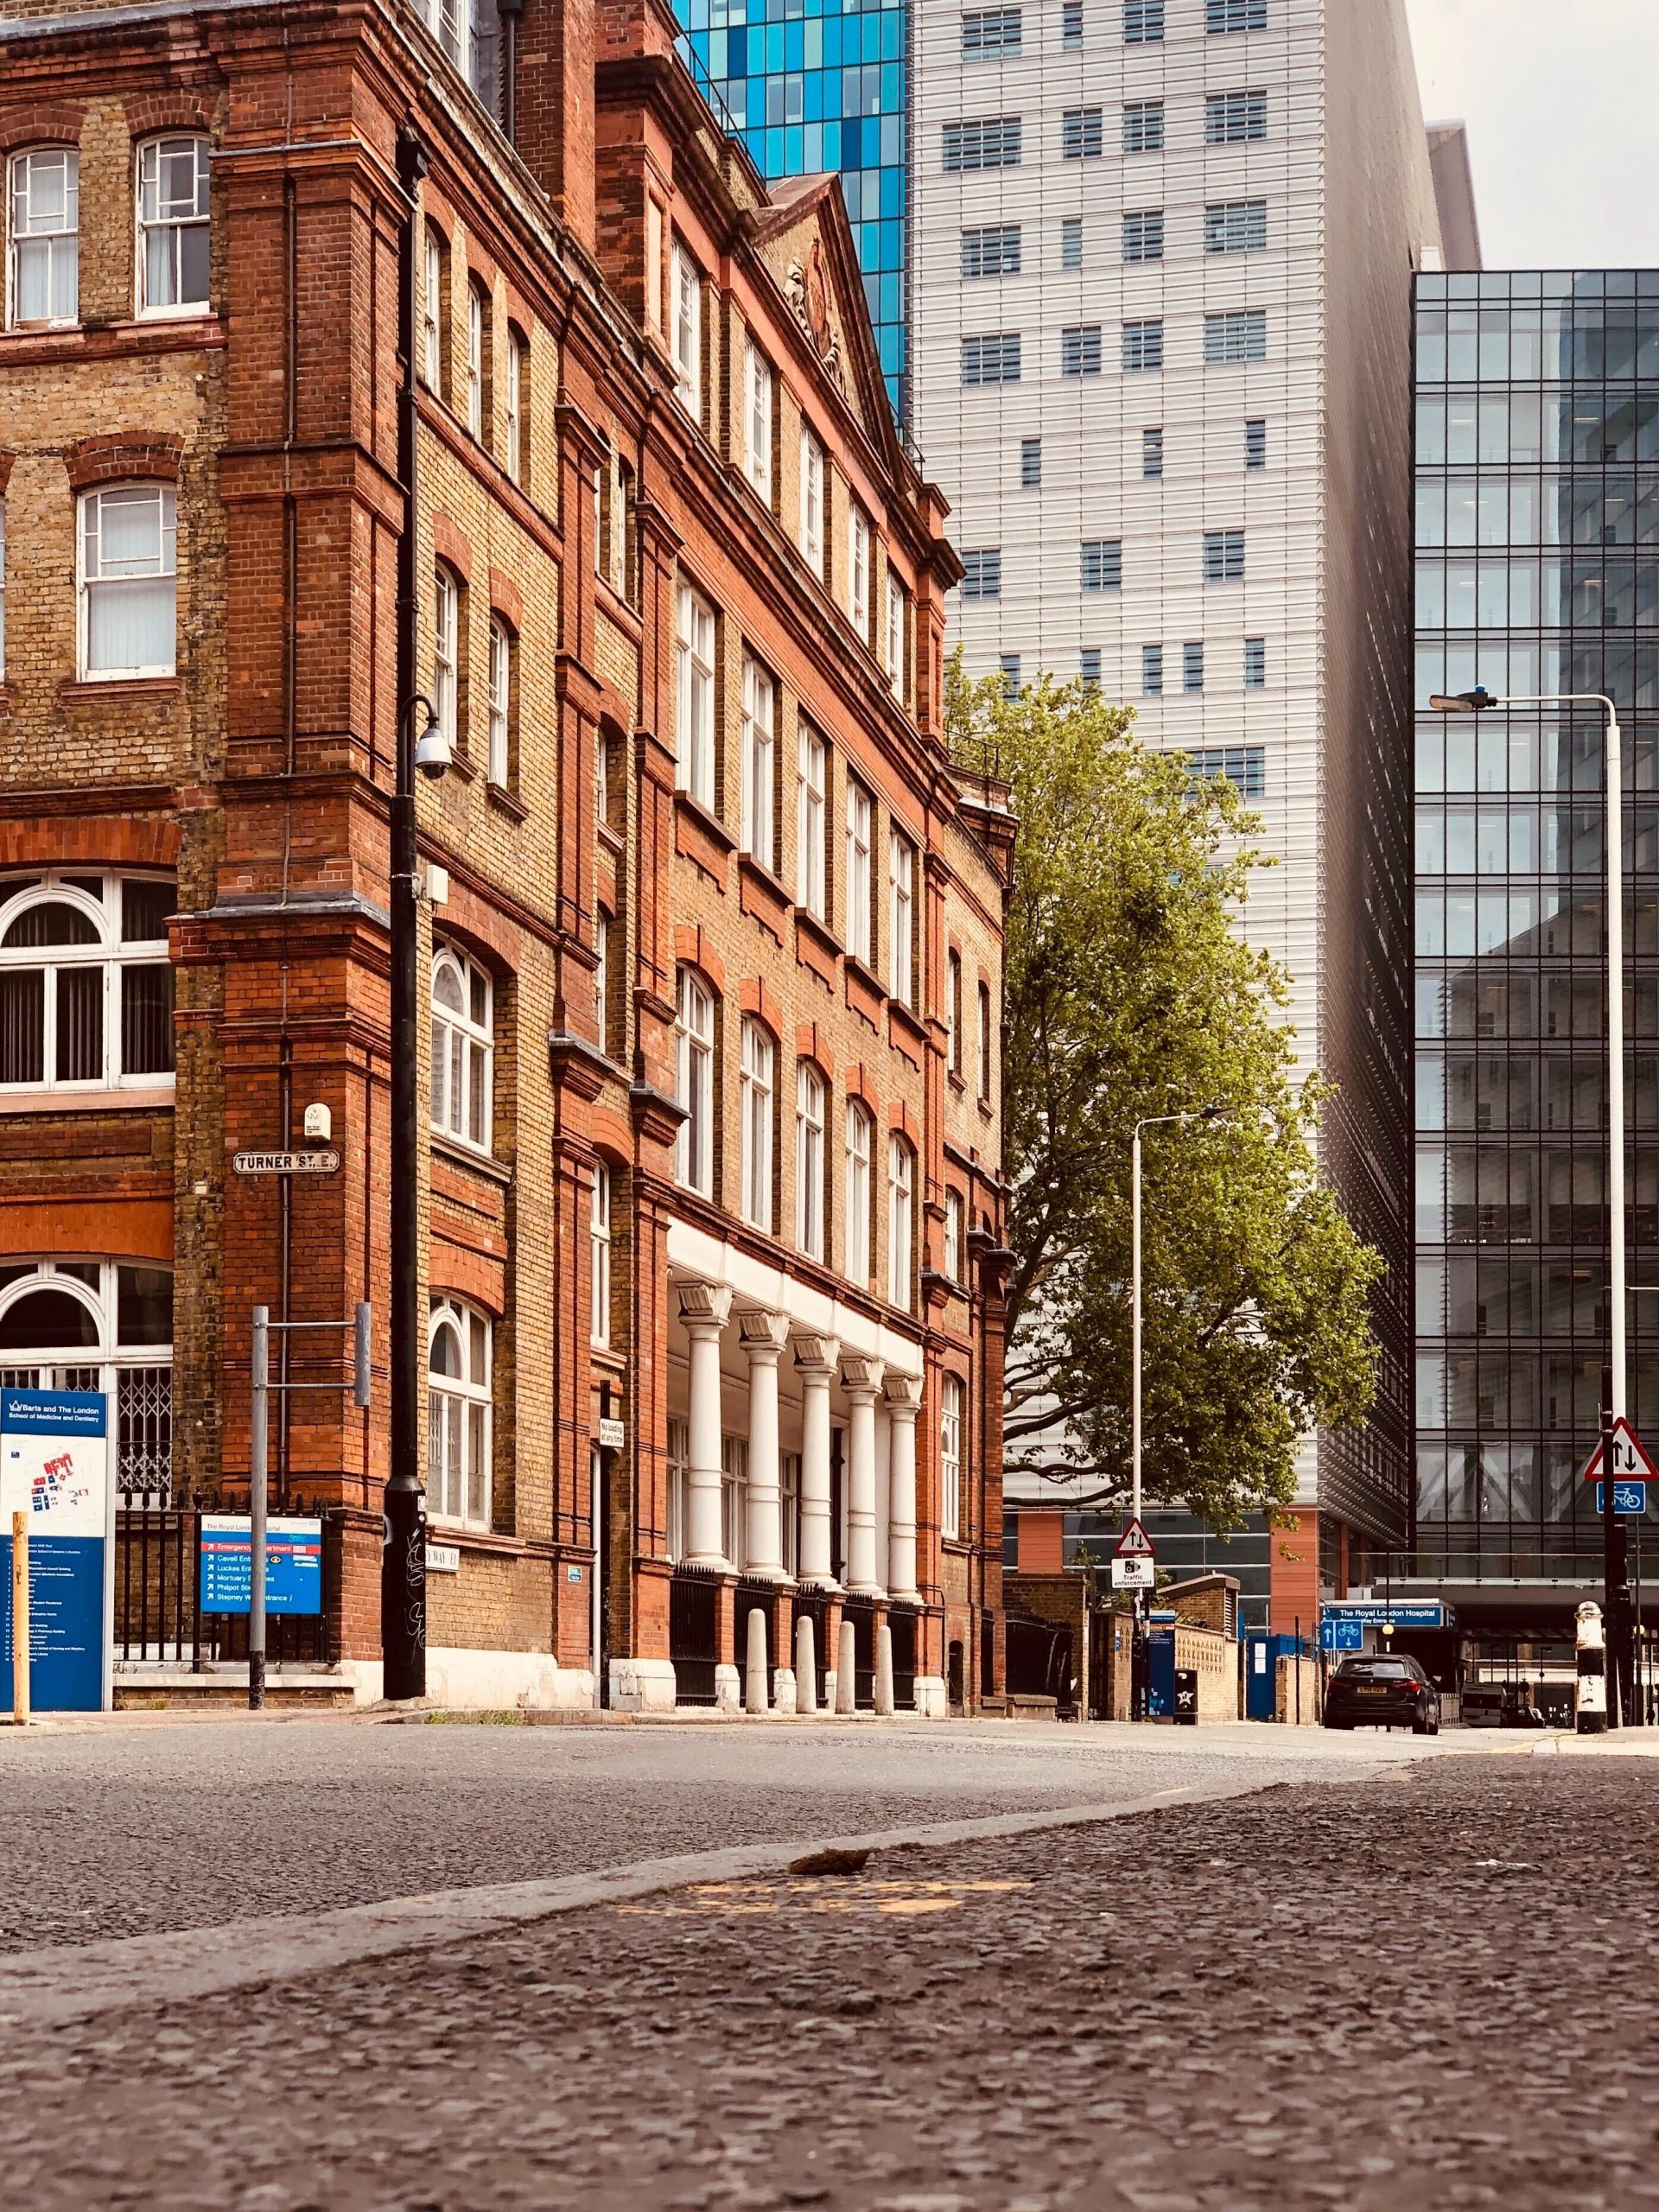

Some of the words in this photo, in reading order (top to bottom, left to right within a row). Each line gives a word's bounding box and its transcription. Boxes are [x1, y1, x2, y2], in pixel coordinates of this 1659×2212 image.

[238, 1156, 292, 1169] TURNER
[217, 1543, 251, 1552] Emergency
[433, 1549, 445, 1564] WAY
[1355, 1610, 1375, 1618] Royal
[1406, 1610, 1435, 1618] Hospital
